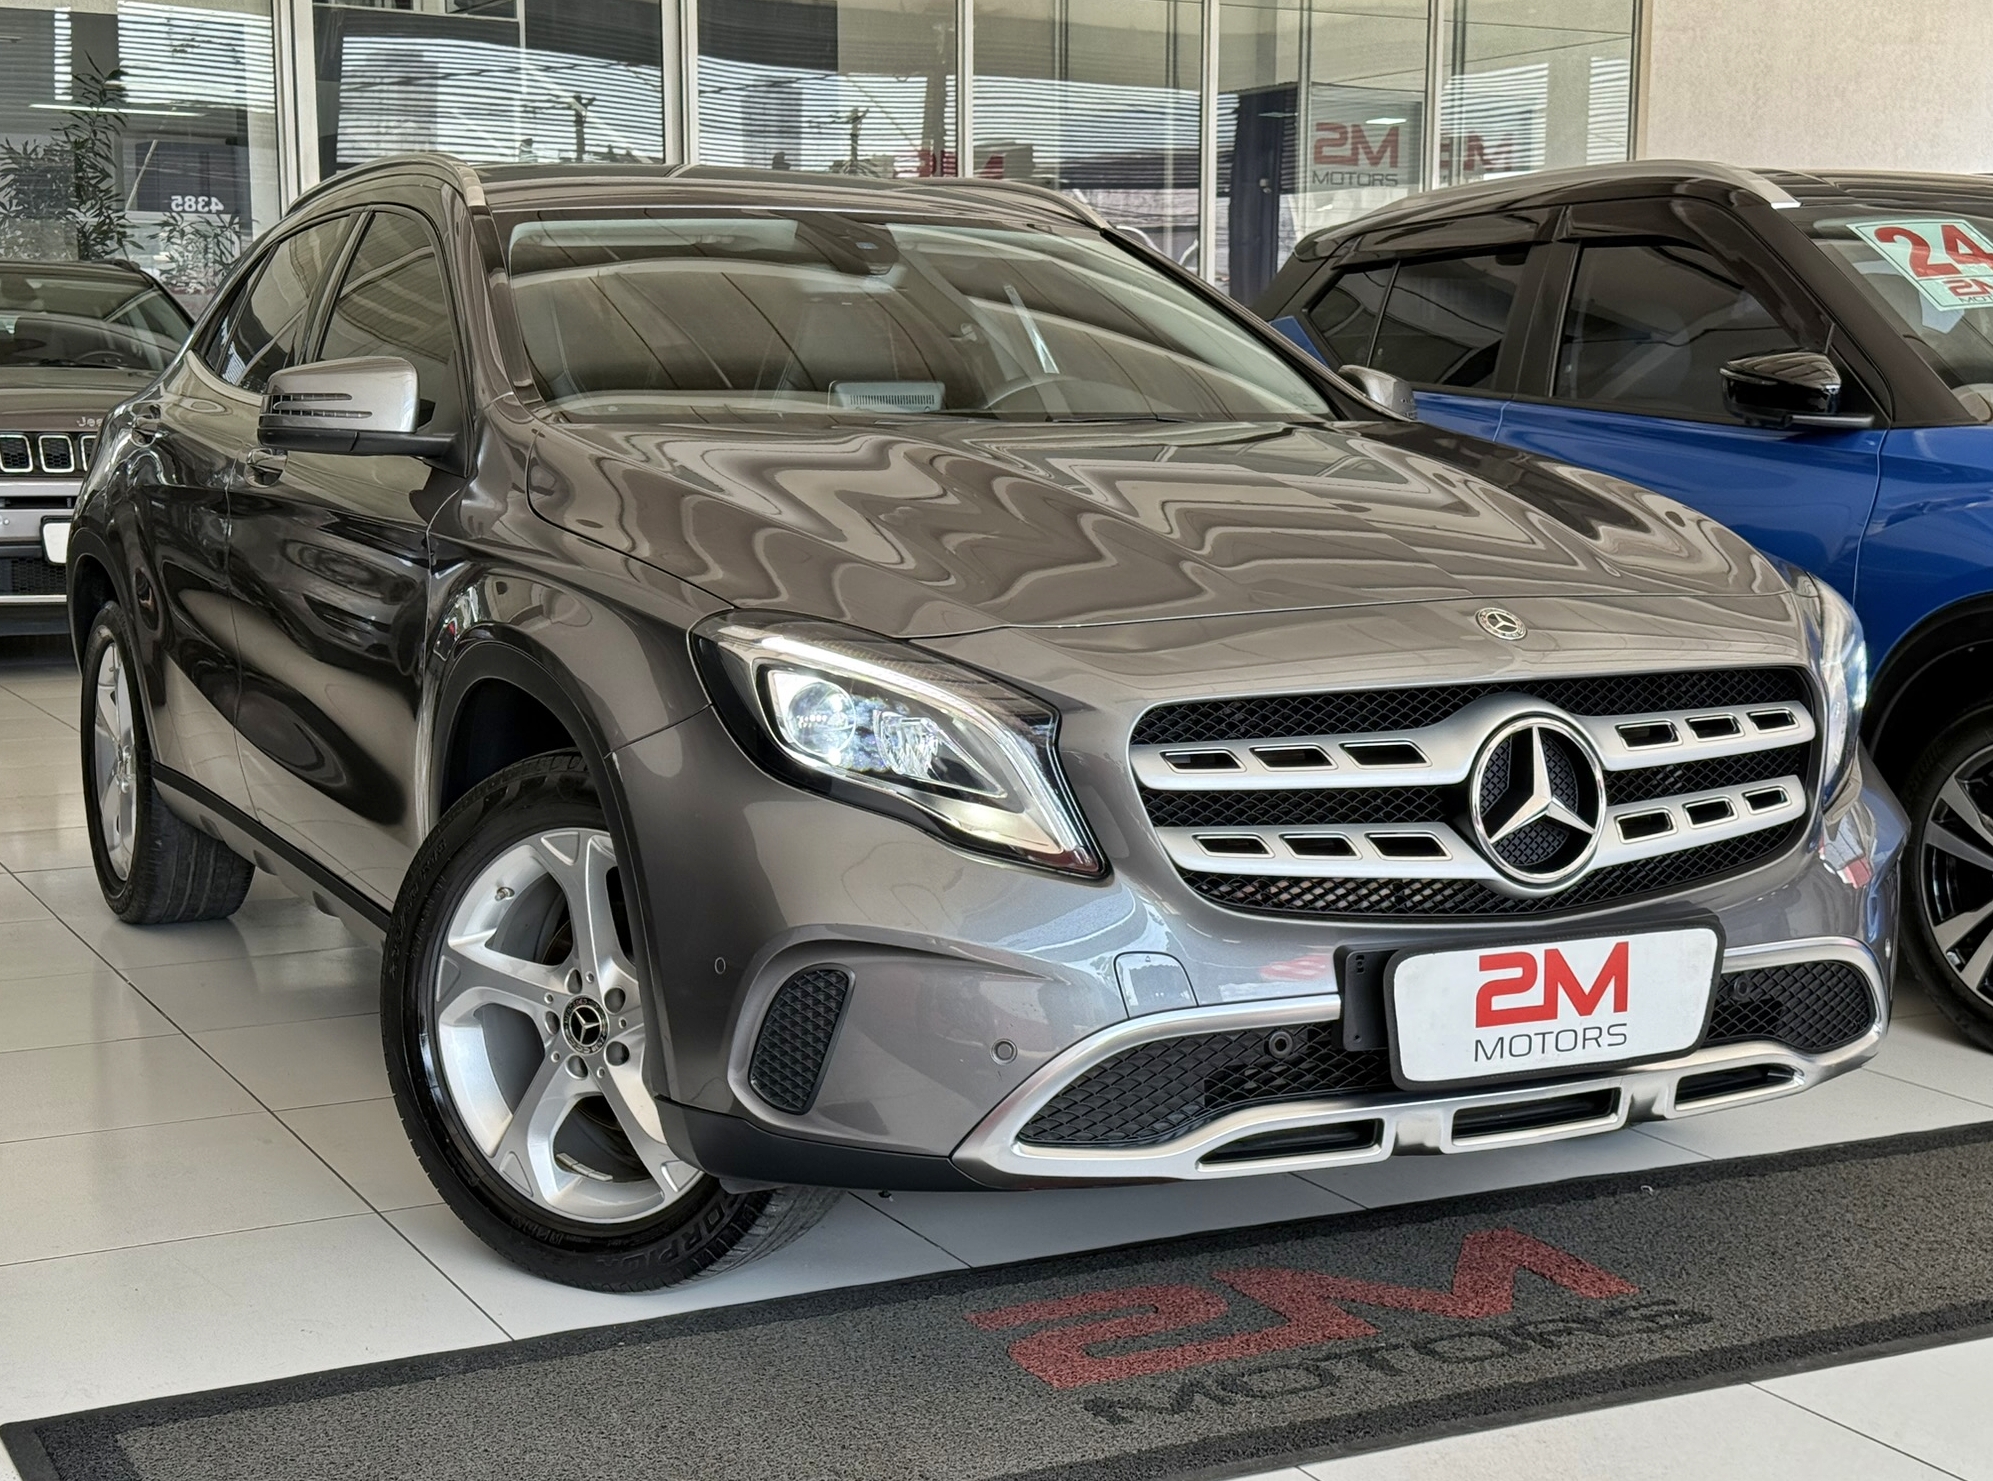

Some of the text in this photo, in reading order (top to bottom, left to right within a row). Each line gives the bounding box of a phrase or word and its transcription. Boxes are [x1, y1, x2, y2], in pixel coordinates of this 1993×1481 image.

[1313, 122, 1399, 168] 2M
[1312, 171, 1398, 187] MOTORS
[76, 416, 104, 427] Jee
[1476, 941, 1629, 1028] 2M
[1474, 1023, 1627, 1062] MOTORS
[967, 1228, 1639, 1388] 2M
[1083, 1300, 1713, 1425] MOTORS
